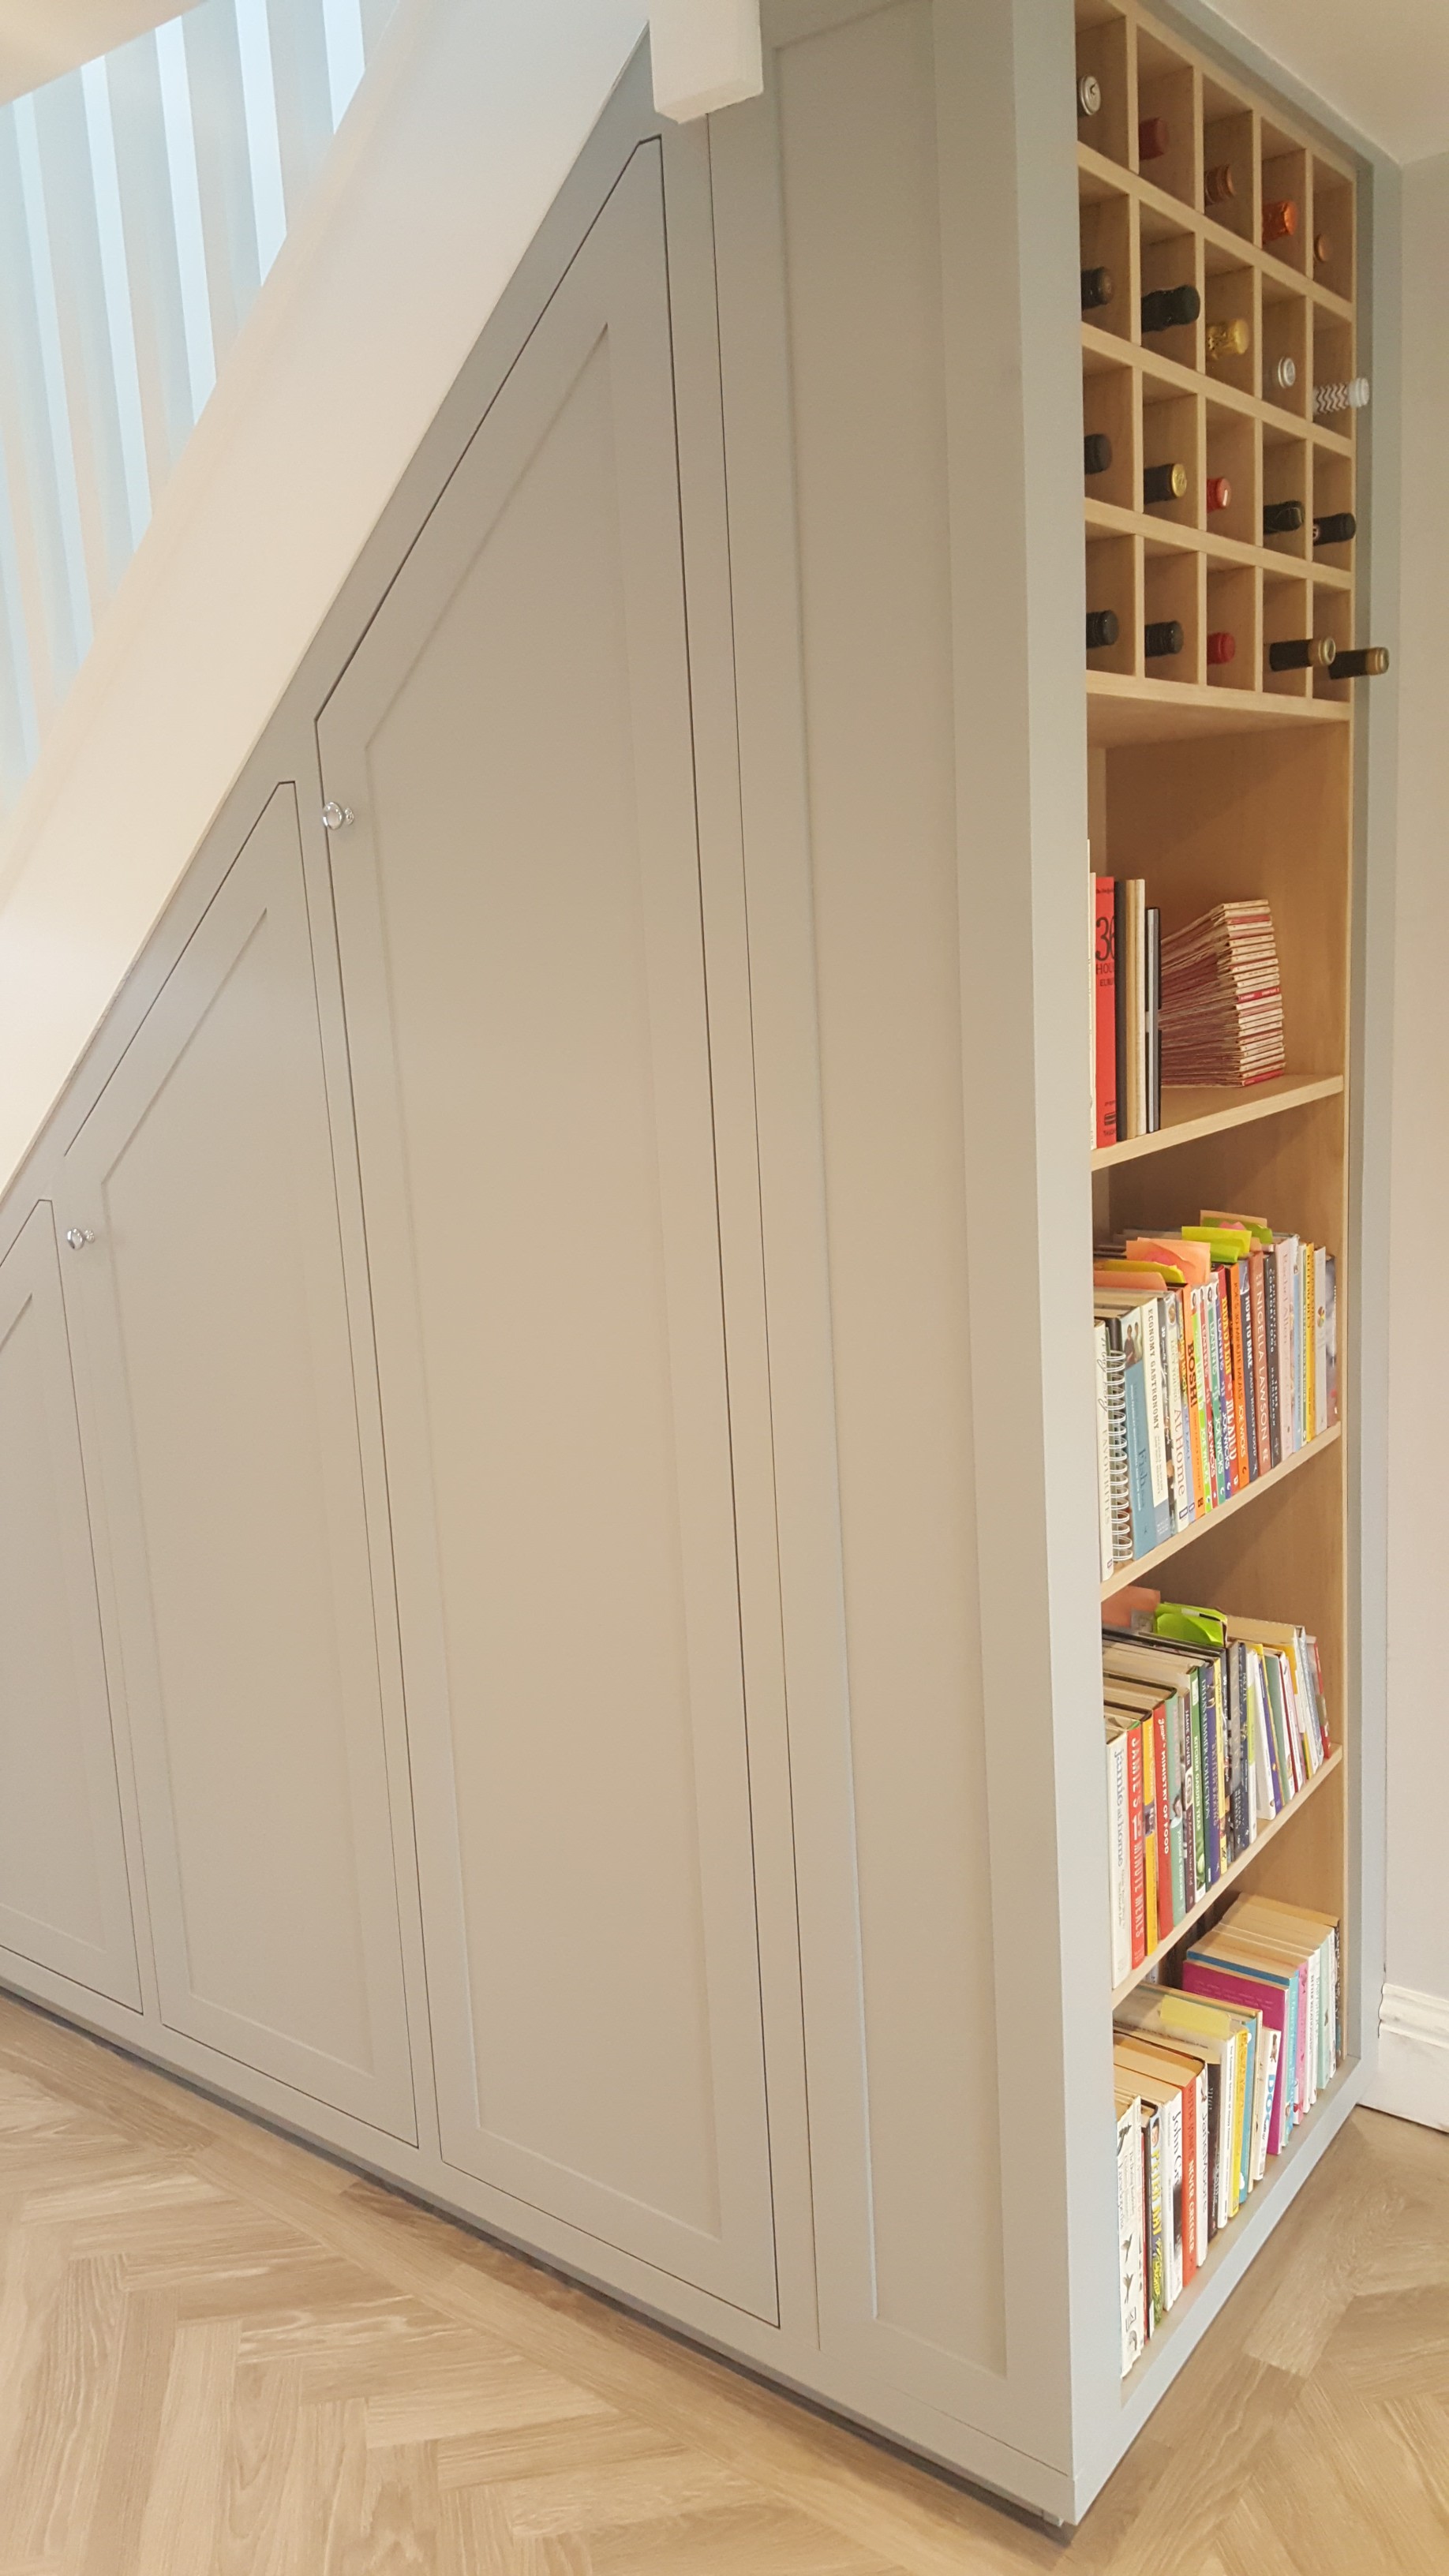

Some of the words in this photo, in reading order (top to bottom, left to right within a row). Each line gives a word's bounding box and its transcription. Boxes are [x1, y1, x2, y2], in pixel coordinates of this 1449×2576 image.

[1095, 963, 1114, 975] HOU
[1246, 1324, 1251, 1339] TO
[1150, 1360, 1159, 1429] GASTRONOMY
[1188, 1342, 1197, 1407] BOSH!
[1174, 1409, 1181, 1432] At
[1259, 1366, 1267, 1440] LAWSON
[1176, 1434, 1185, 1496] Home
[1114, 1749, 1124, 1806] jamie
[1132, 1737, 1141, 1808] JAMIE'S
[1163, 1804, 1168, 1820] OF
[1133, 1842, 1143, 1892] MINUTE
[1135, 1895, 1144, 1938] MEALS
[1173, 2111, 1181, 2154] John
[1151, 2148, 1160, 2202] PETER
